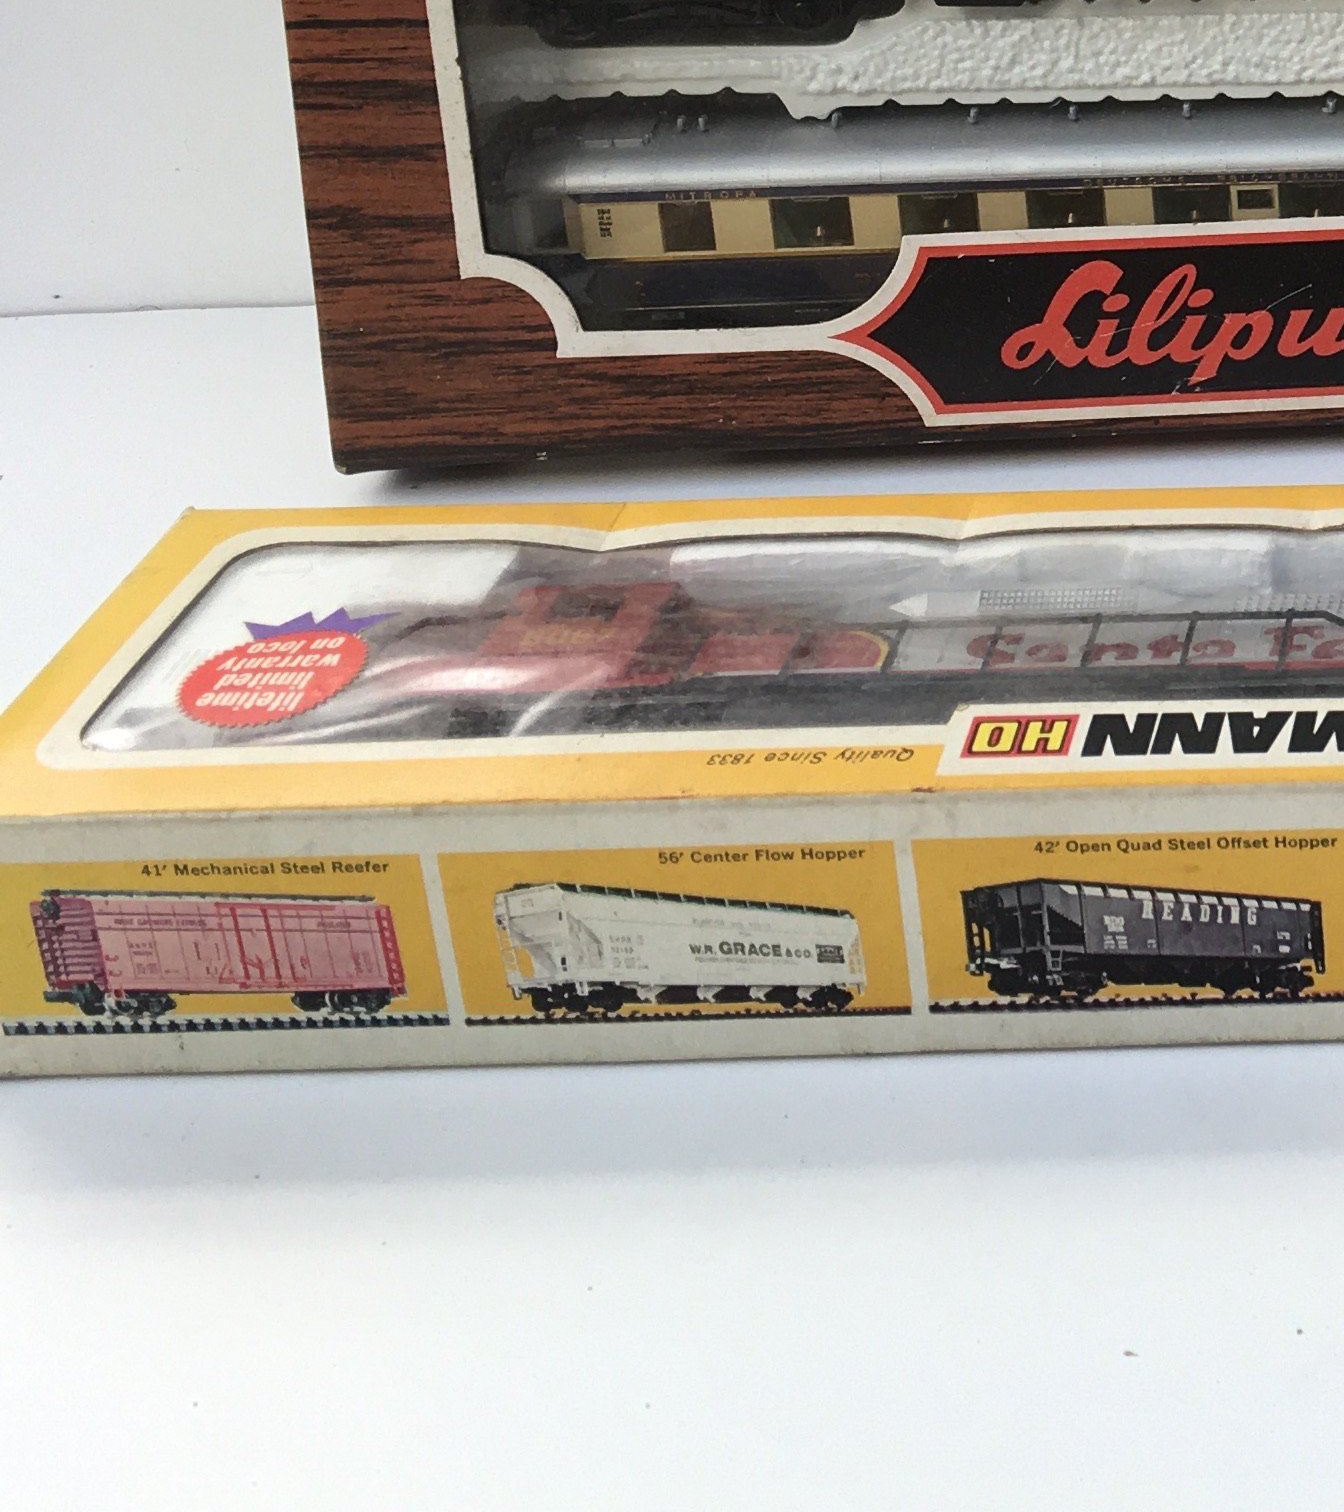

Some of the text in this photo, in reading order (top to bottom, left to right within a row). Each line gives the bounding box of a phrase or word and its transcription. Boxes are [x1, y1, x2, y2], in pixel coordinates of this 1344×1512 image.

[246, 636, 347, 655] on loco
[966, 631, 1237, 665] Santa
[215, 653, 342, 672] warranty
[213, 671, 315, 691] limited
[195, 691, 305, 712] lifetime
[973, 720, 1070, 753] HO
[706, 746, 915, 766] Quality Since 1833
[1065, 840, 1112, 855] Open
[1116, 839, 1162, 853] Quad
[1168, 838, 1212, 851] Steel
[1216, 836, 1269, 850] Offset
[1274, 836, 1338, 851] Hopper
[690, 850, 750, 864] Center
[754, 848, 795, 862] Flow
[800, 847, 866, 863] Hopper
[173, 862, 276, 877] Mechanical
[280, 861, 326, 875] Steel
[331, 861, 390, 874] Reefer
[1141, 899, 1258, 926] READING
[718, 941, 783, 958] GRACE
